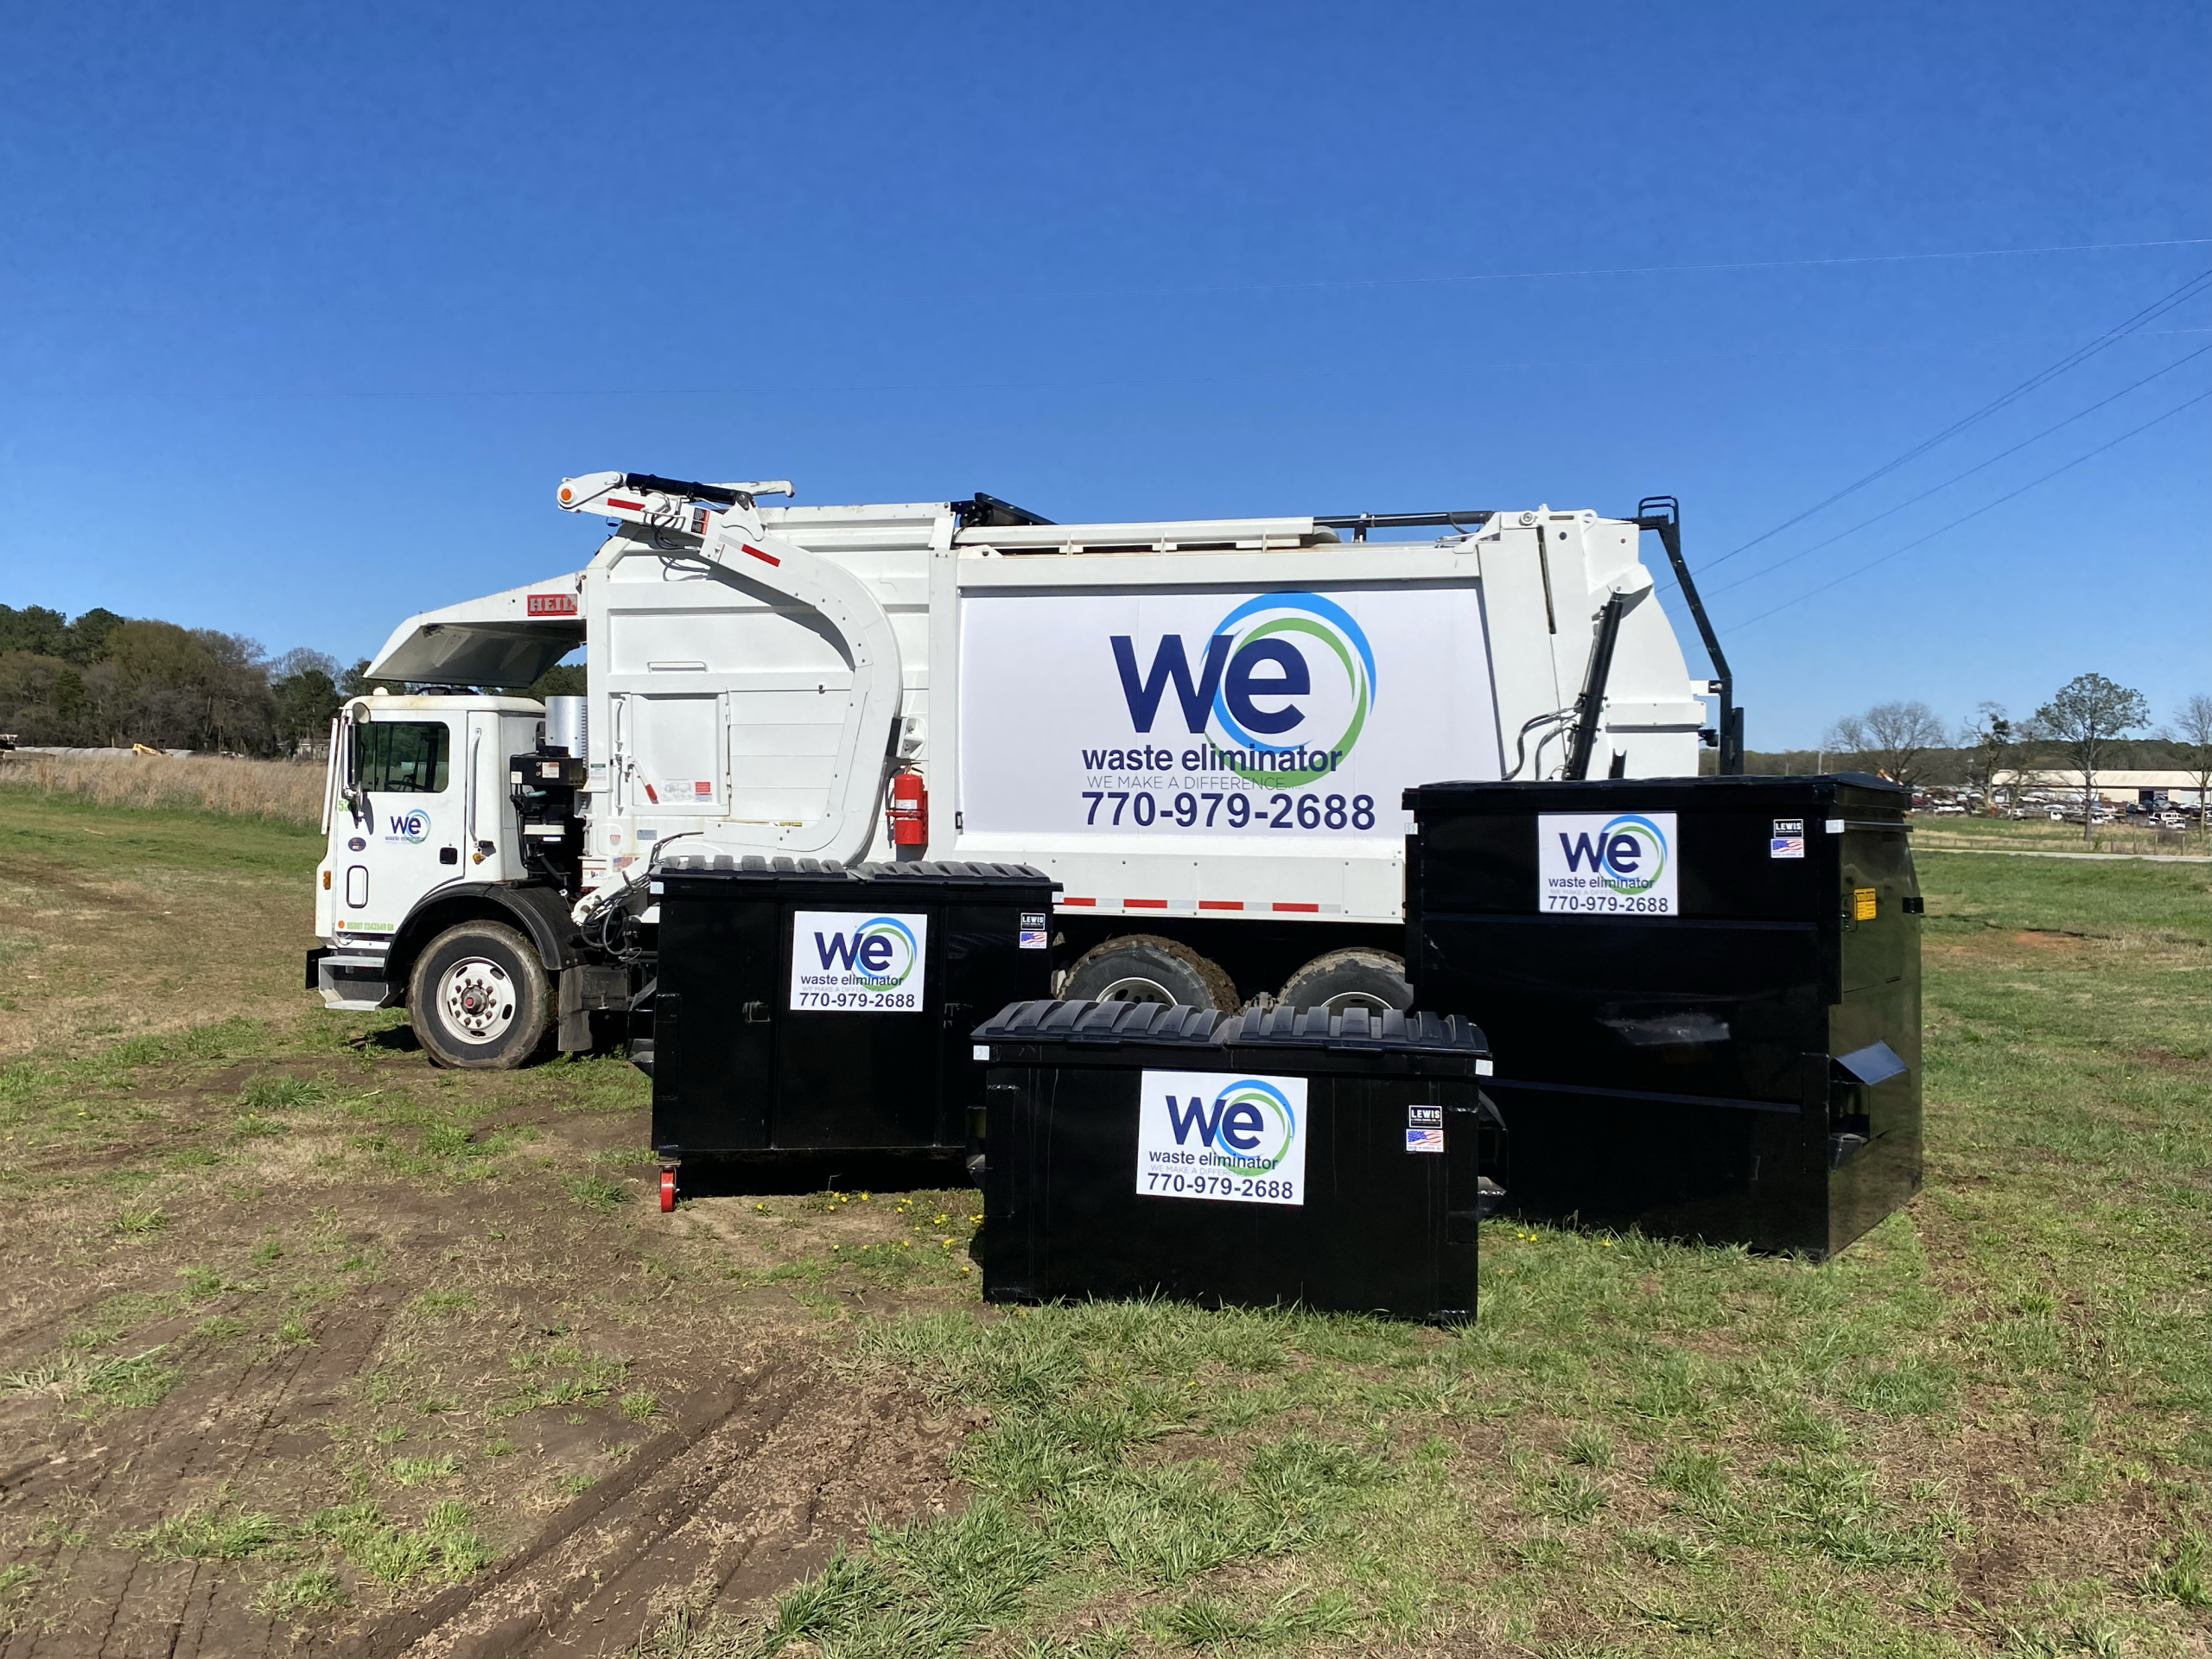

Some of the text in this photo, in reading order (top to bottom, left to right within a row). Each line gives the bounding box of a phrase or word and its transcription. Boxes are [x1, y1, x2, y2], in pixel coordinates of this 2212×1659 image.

[530, 597, 573, 612] HEIL
[1082, 743, 1342, 772] waste eliminator
[1087, 776, 1113, 789] WE
[1118, 776, 1163, 789] MAKE
[1167, 776, 1179, 789] A
[1082, 791, 1376, 830] 770-979-2688
[1548, 876, 1655, 888] waste eliminator
[1548, 895, 1669, 912] 770-979-2688
[800, 974, 904, 986] waste eliminator
[799, 992, 915, 1007] 770-979-2688
[1411, 1109, 1440, 1119] LEWIS
[1149, 1151, 1279, 1170] waste eliminator
[1166, 1166, 1190, 1174] MAKE
[1147, 1172, 1294, 1199] 770-979-2688
